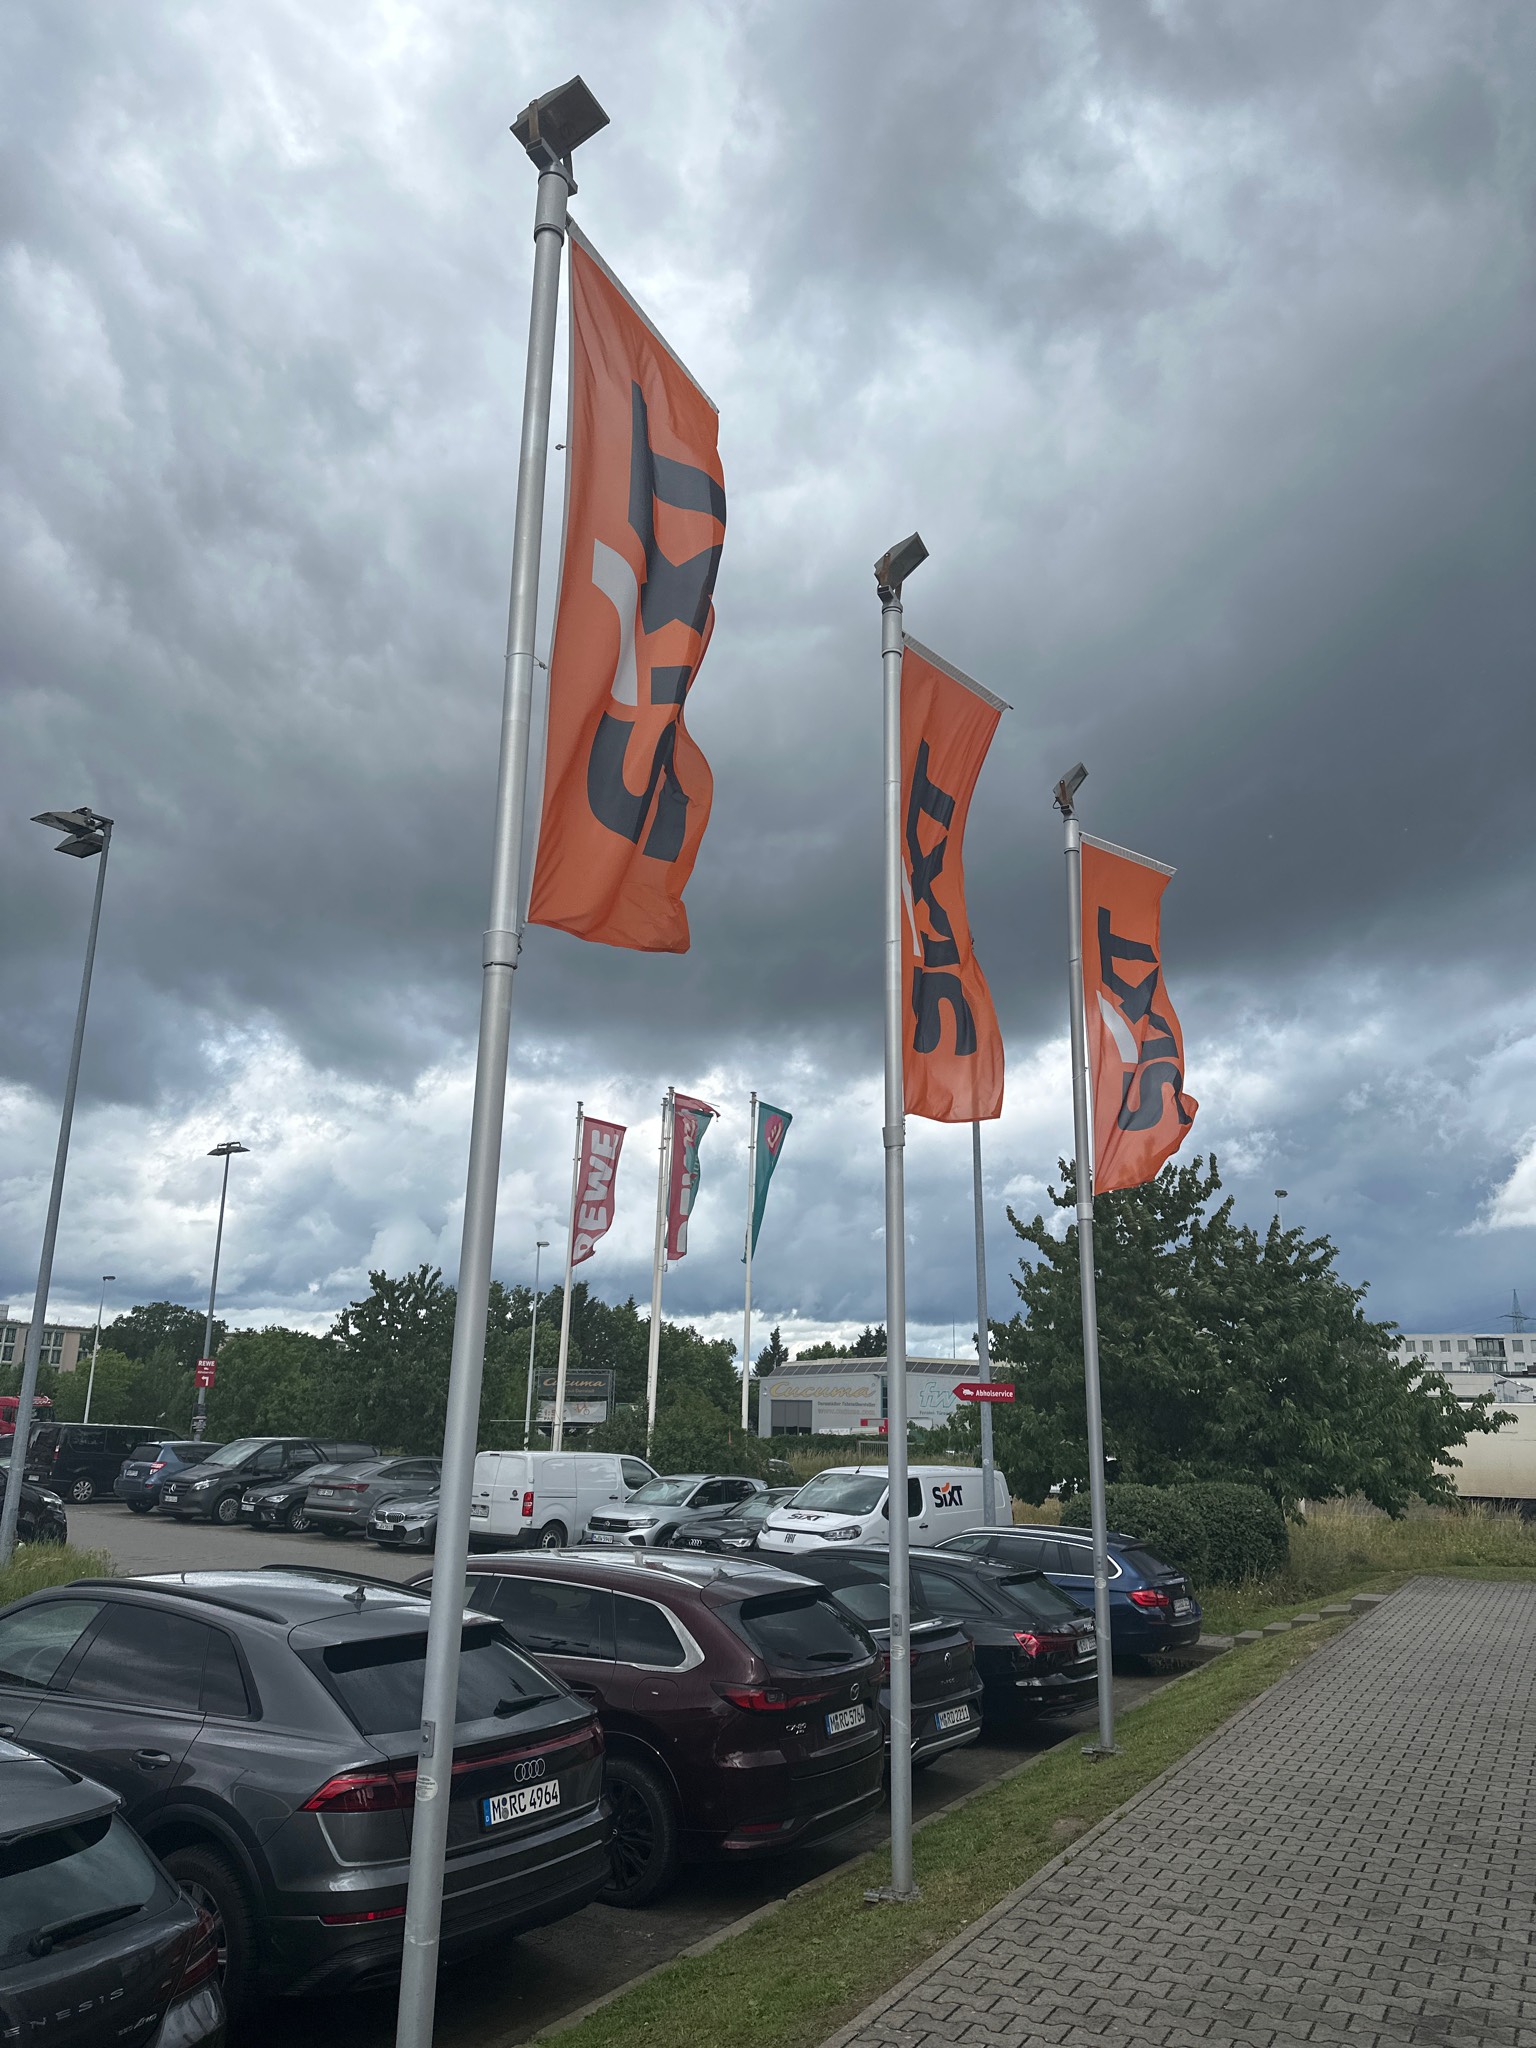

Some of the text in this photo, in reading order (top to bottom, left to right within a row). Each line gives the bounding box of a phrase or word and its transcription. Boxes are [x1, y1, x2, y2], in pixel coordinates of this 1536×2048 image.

[573, 1129, 619, 1260] REWE
[769, 1381, 876, 1398] Cucuma
[975, 1389, 1014, 1398] Abholservice
[932, 1482, 963, 1508] SIXT
[787, 1512, 825, 1522] SIXT
[784, 1533, 797, 1544] FIAT
[849, 1707, 865, 1725] 5764
[529, 1783, 559, 1809] 4964
[3, 1988, 124, 2038] ENESIS
